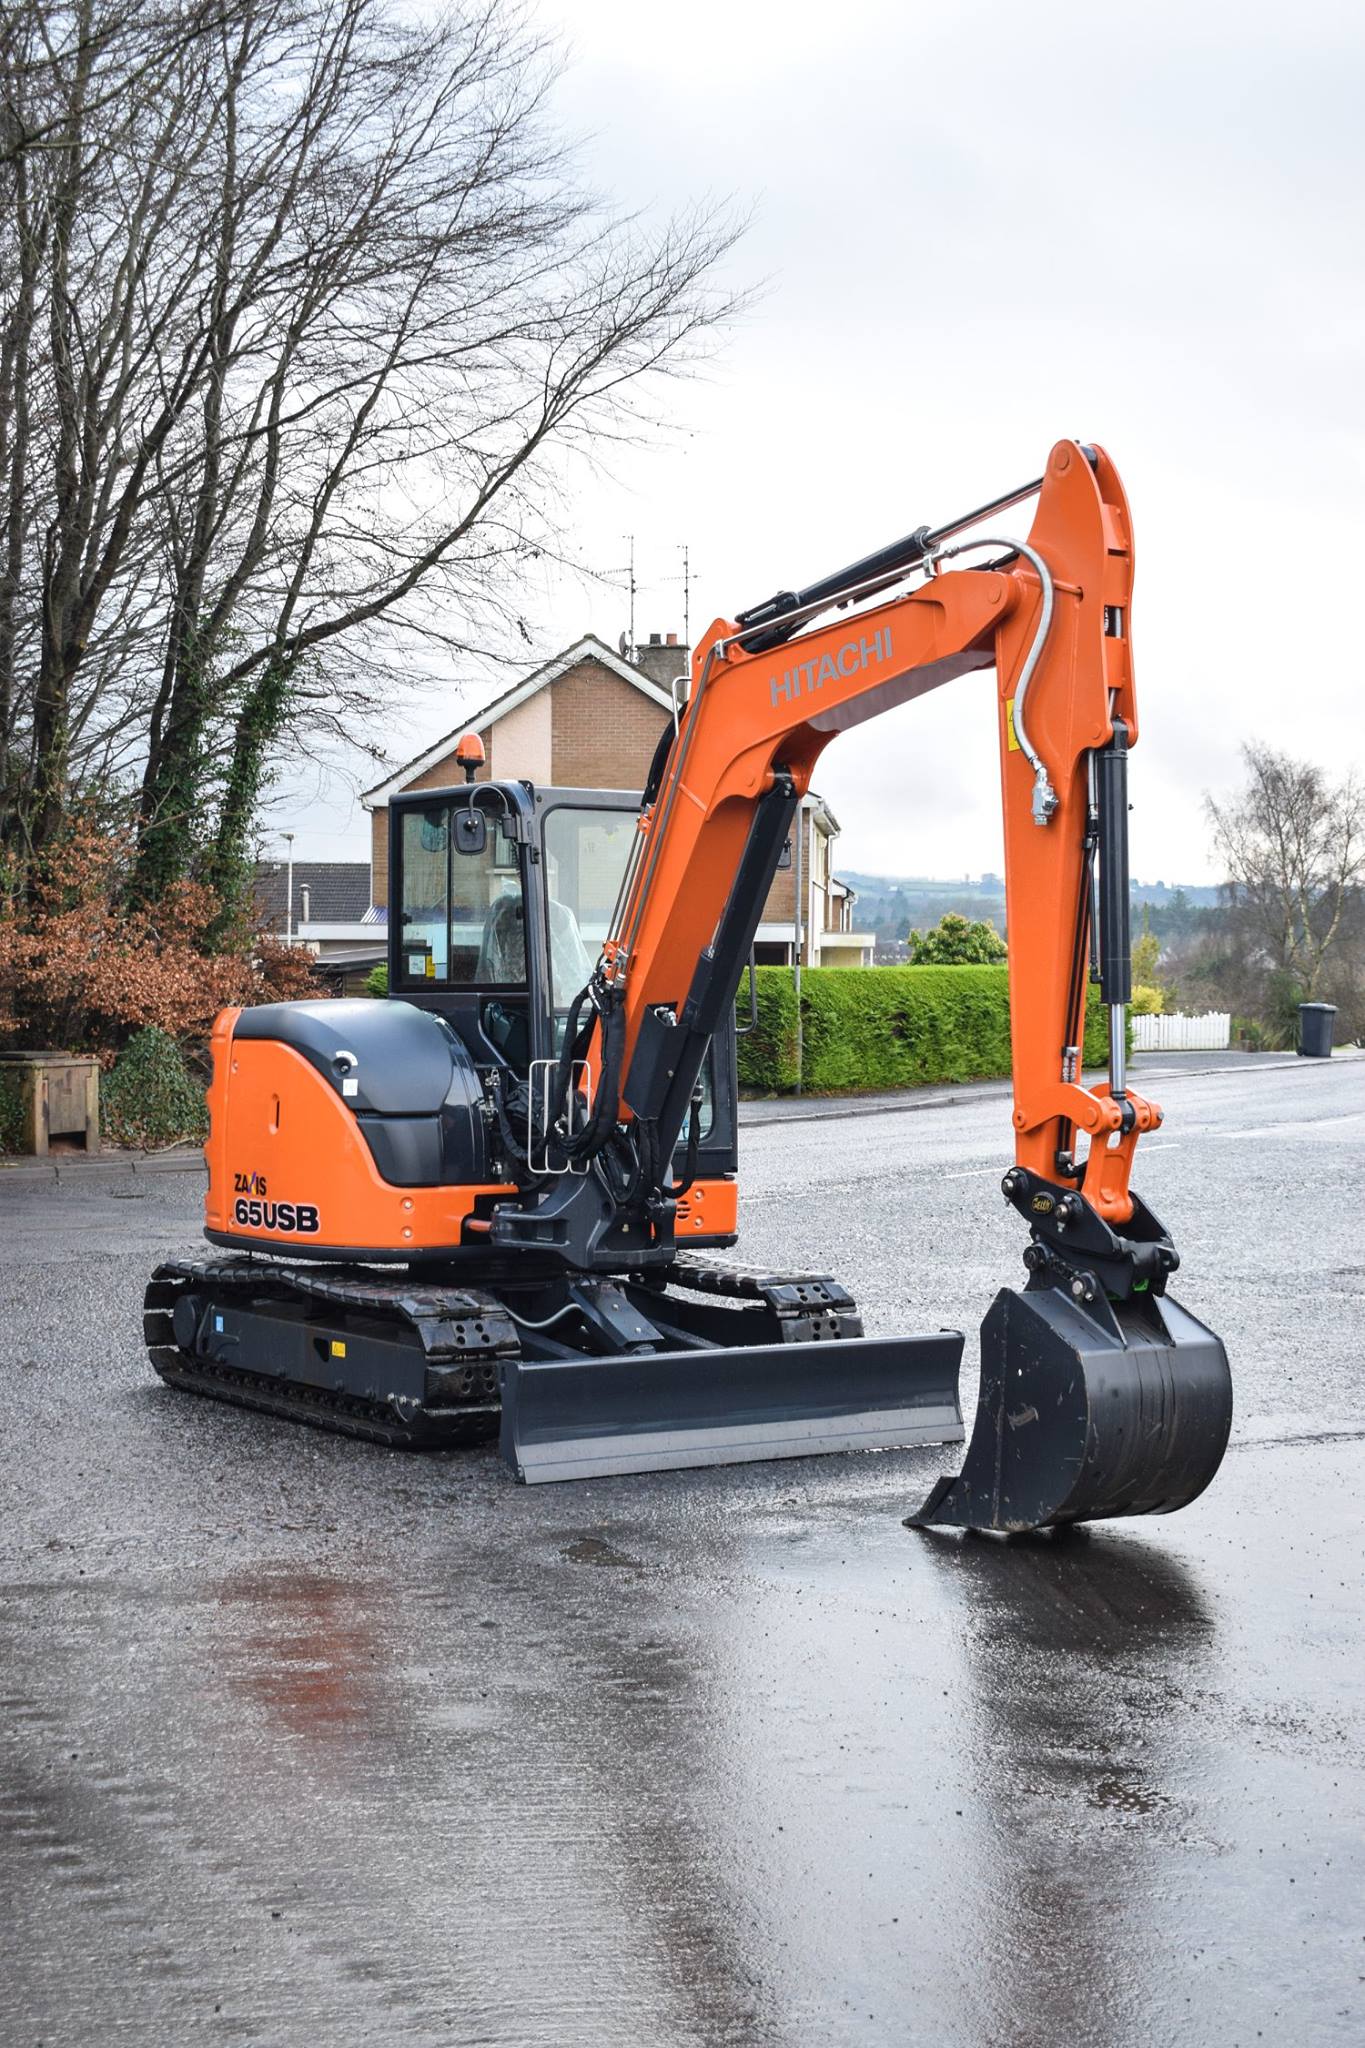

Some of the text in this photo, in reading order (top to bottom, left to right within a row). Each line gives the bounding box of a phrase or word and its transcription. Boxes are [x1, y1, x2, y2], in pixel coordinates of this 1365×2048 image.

[769, 626, 893, 707] HITACHI
[234, 1172, 267, 1196] ZAXIS
[235, 1198, 320, 1233] 65USB
